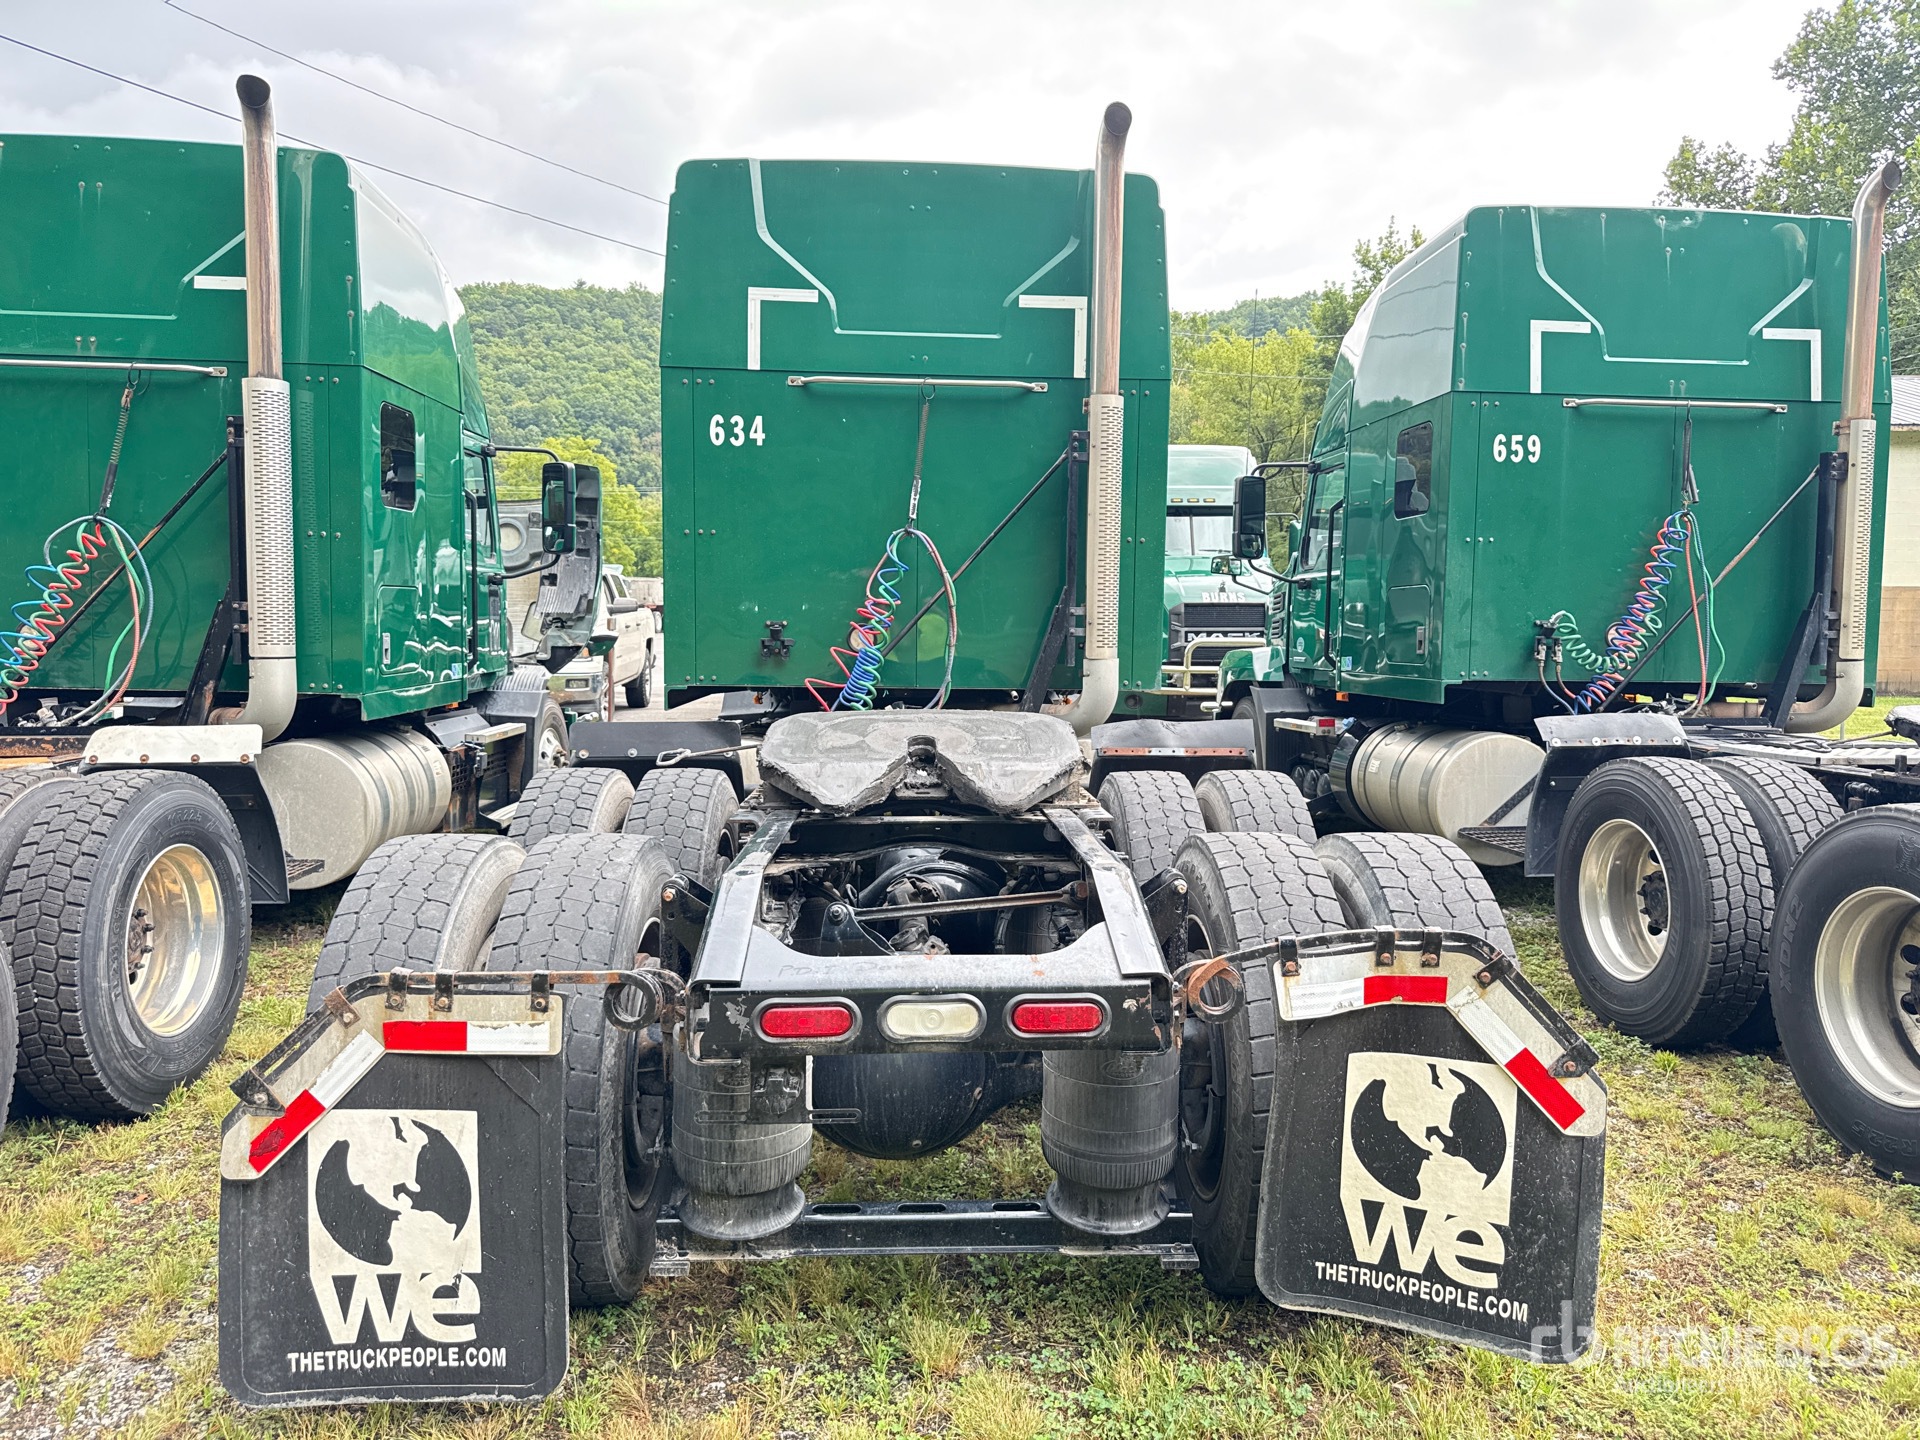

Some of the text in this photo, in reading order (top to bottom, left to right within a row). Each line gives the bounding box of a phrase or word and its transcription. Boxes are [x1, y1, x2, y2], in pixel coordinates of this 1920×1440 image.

[709, 414, 766, 447] 634
[1492, 433, 1541, 464] 659
[1201, 591, 1246, 603] BURNS
[1314, 1260, 1529, 1323] THETRUCKPEOPLE.COM
[287, 1346, 507, 1373] THETRUCKPEOPLE.COM
